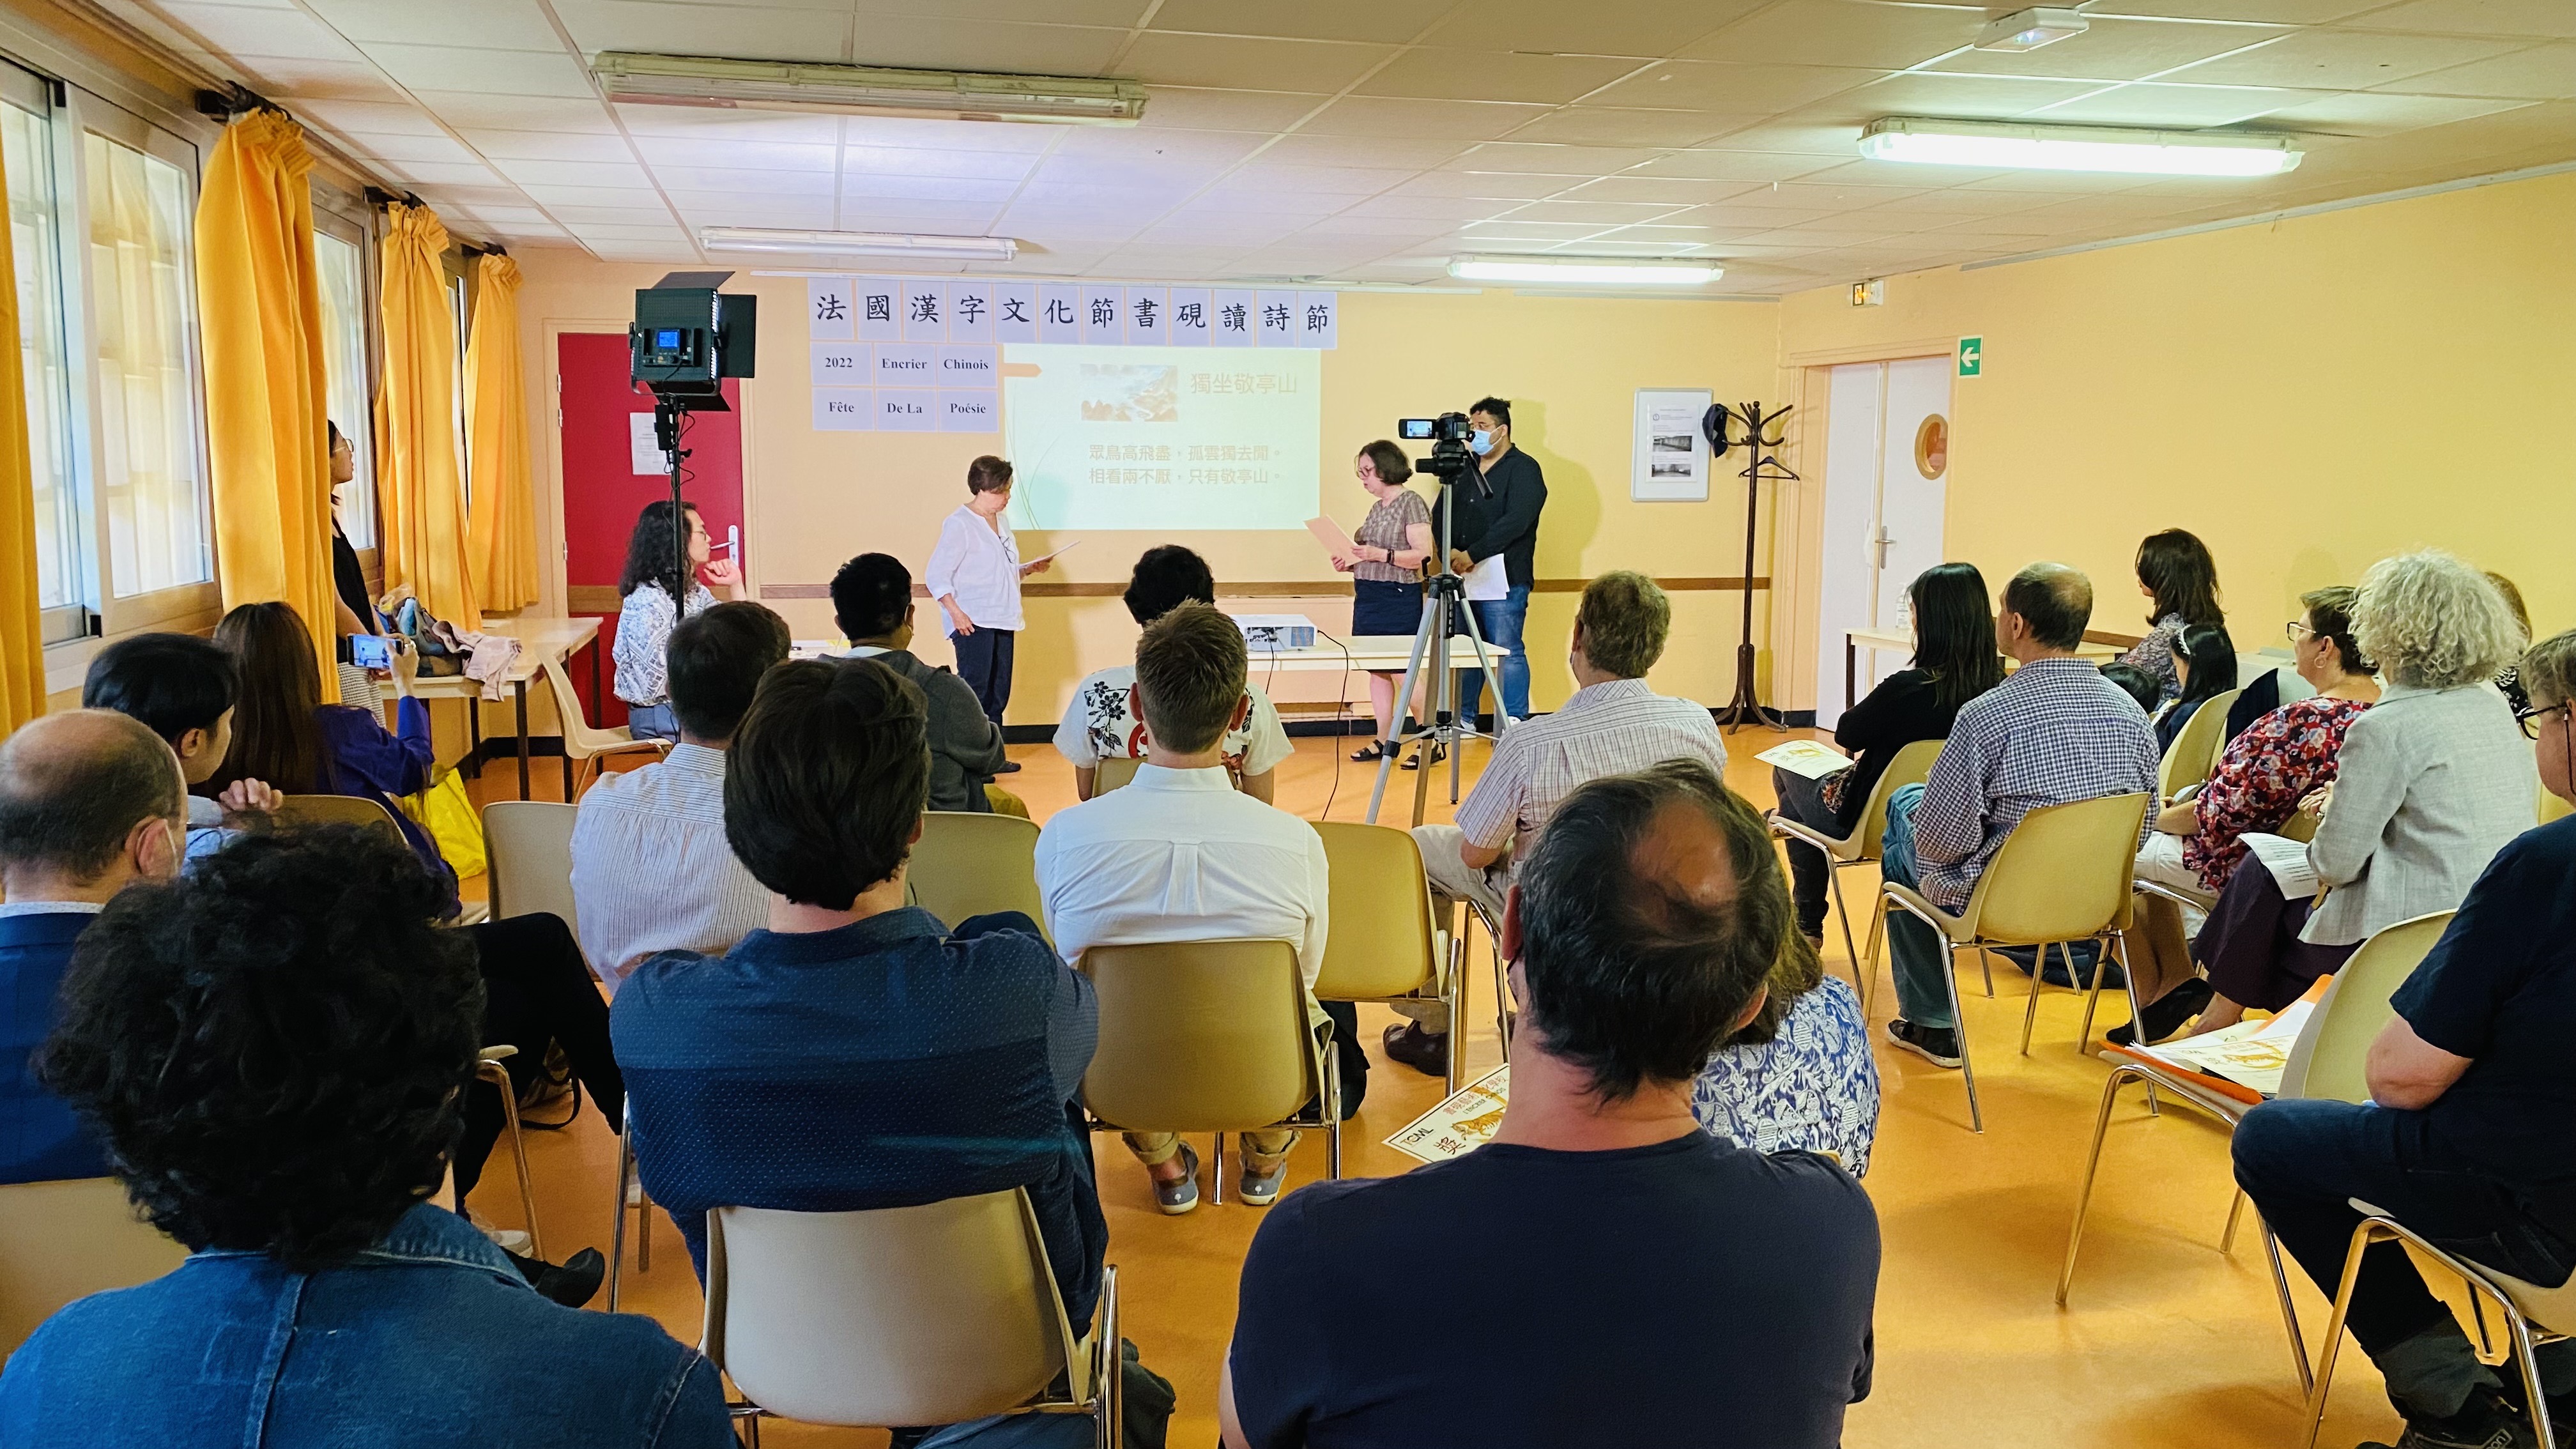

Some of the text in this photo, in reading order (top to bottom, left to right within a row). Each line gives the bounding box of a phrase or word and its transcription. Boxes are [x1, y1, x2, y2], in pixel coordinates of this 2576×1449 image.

[816, 293, 1329, 334] 法國漢字文化節書硯讀詩節
[824, 357, 989, 370] 2022 Encrier Chinois
[1190, 372, 1298, 395] 獨坐敬亭山
[829, 401, 986, 414] Fête De La Poésie
